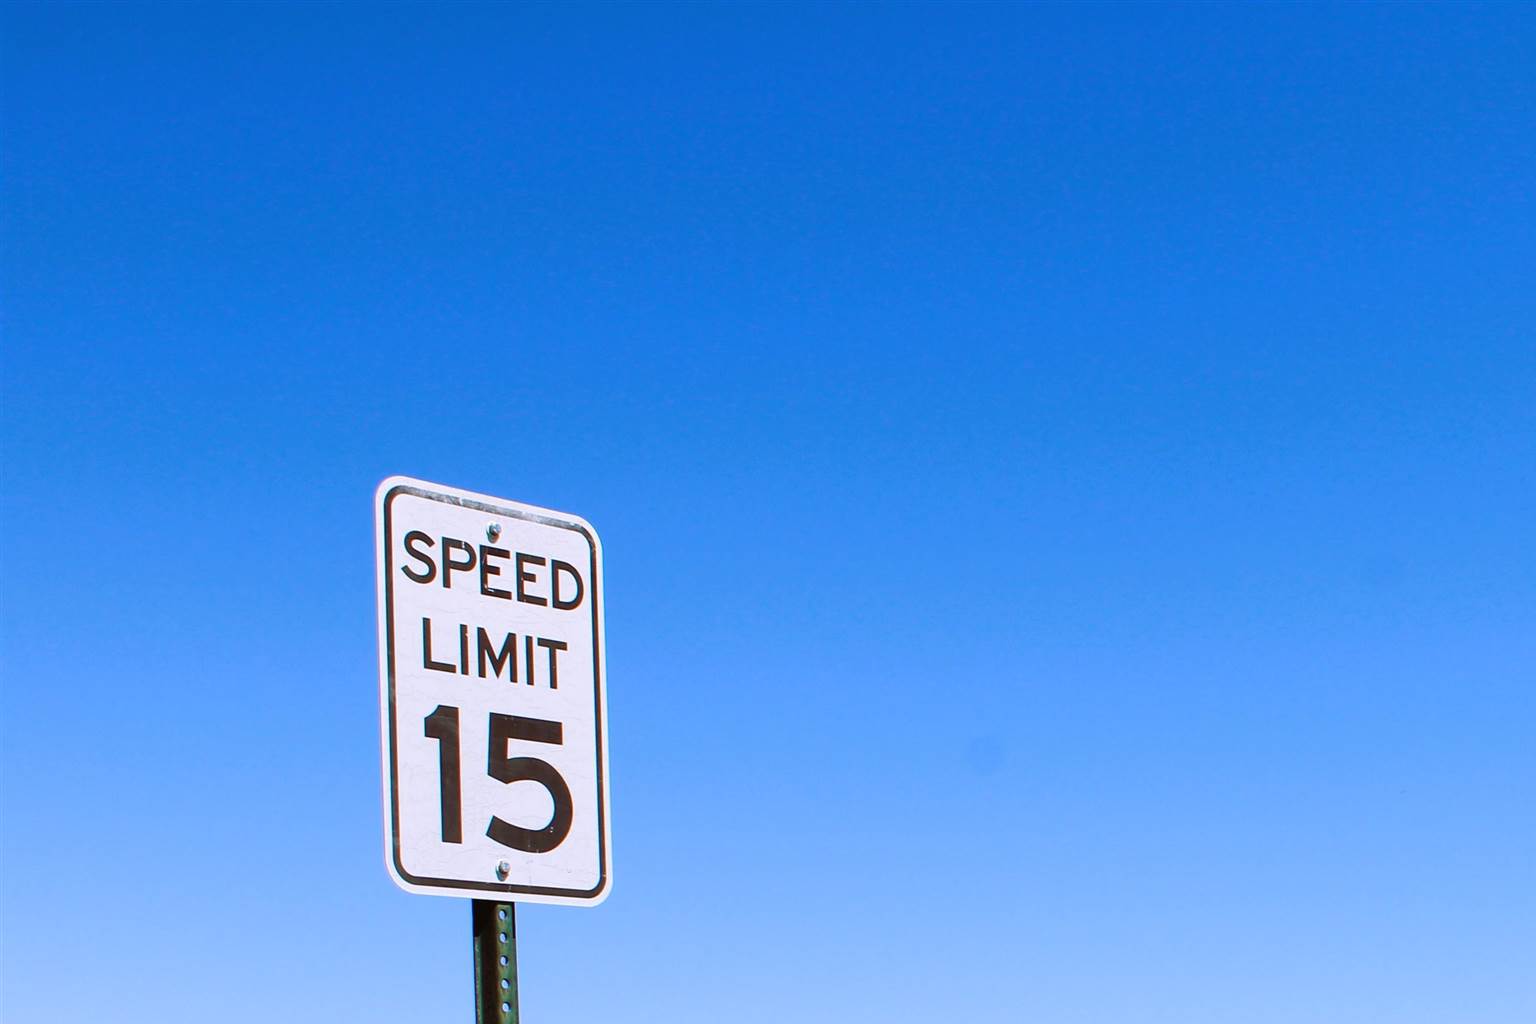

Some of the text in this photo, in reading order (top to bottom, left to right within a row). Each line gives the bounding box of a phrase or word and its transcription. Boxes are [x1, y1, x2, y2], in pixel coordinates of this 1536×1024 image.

[401, 530, 584, 611] SPEED
[422, 617, 568, 690] LIMIT
[424, 704, 574, 854] 15
